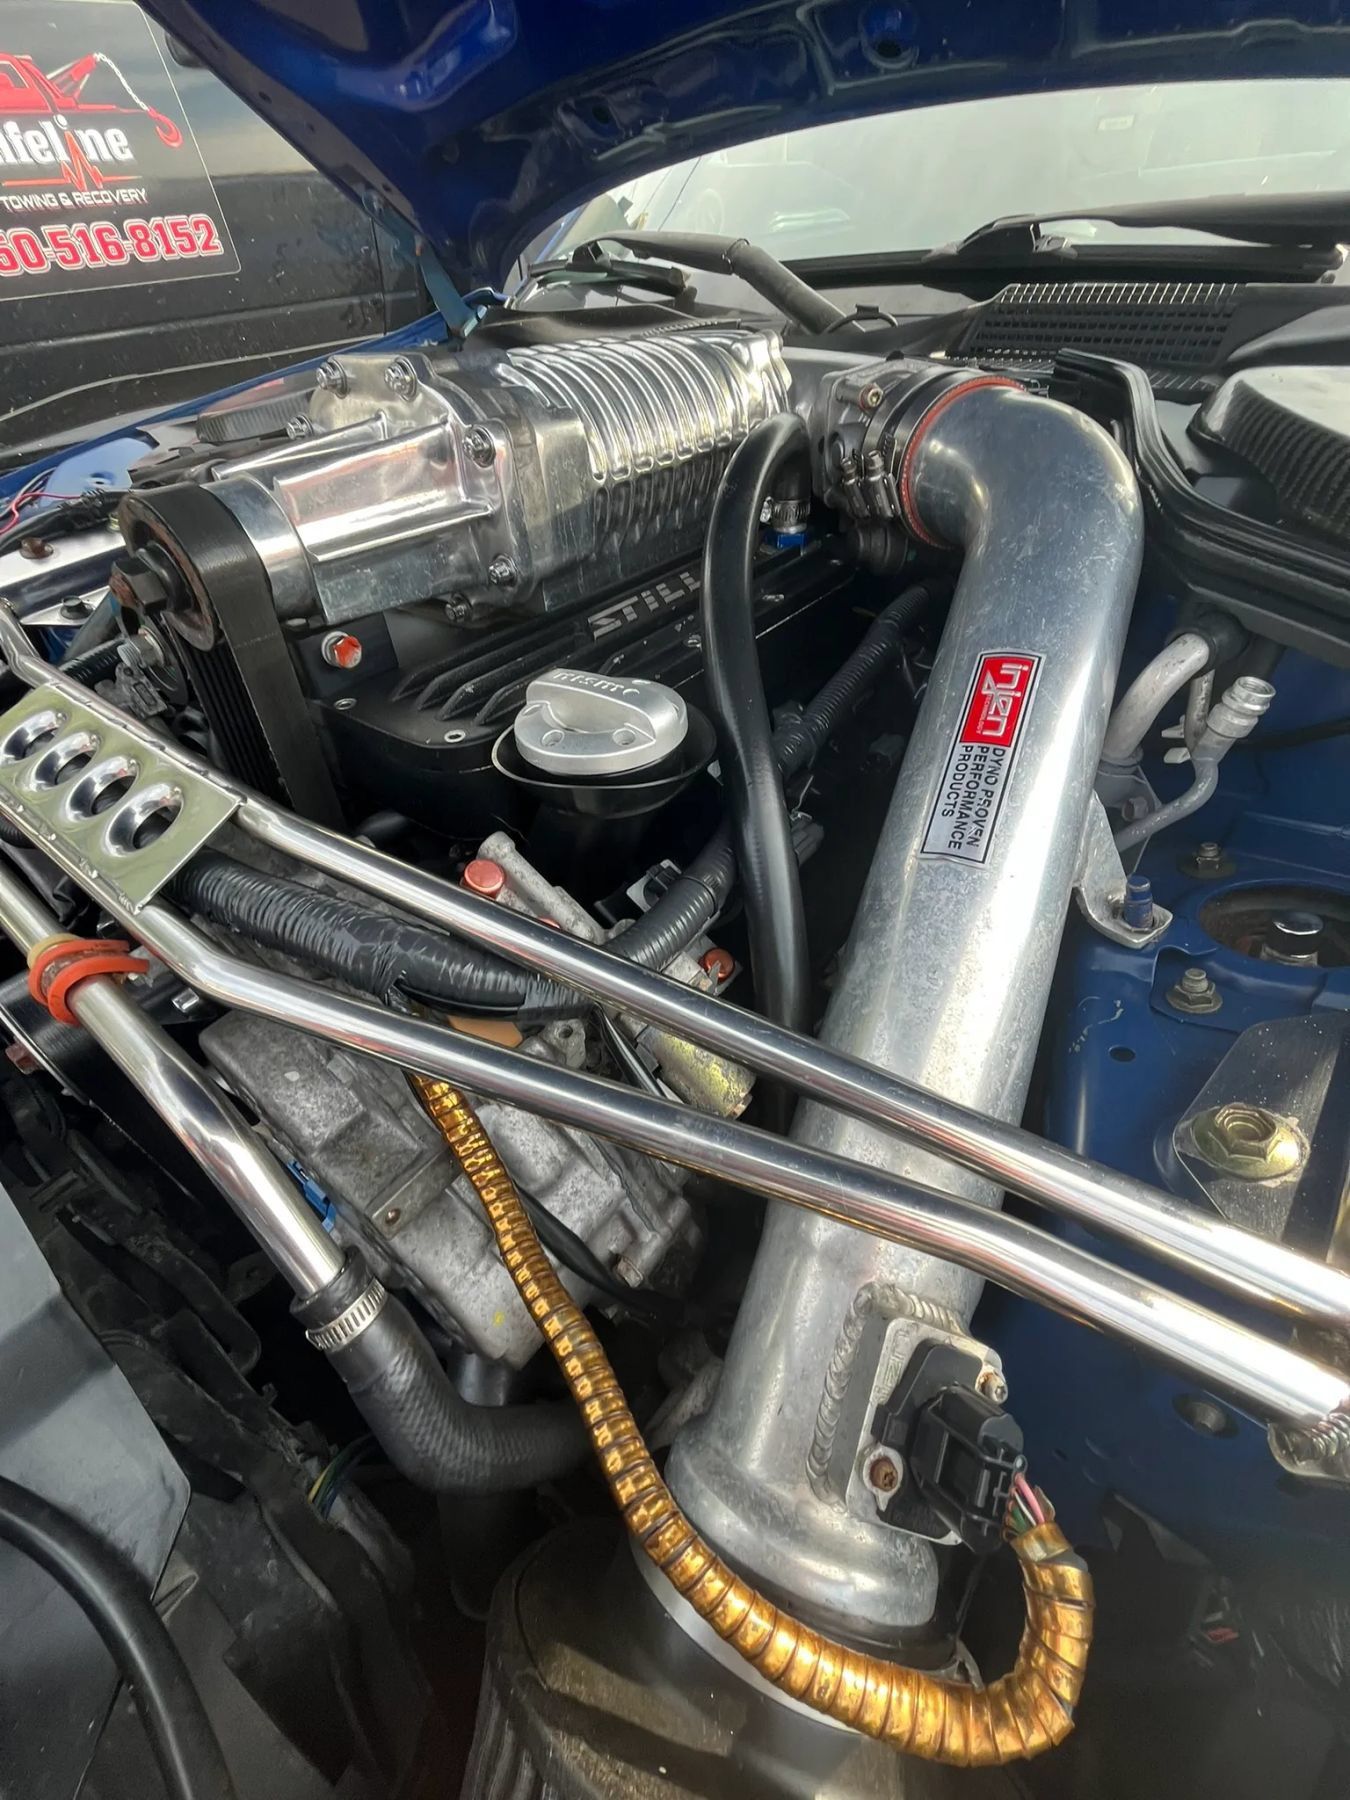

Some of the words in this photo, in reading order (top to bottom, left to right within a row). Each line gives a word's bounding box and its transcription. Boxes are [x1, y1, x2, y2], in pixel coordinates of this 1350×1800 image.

[0, 192, 60, 211] TOWING
[59, 191, 74, 206] &
[73, 188, 147, 206] RECOVERY
[976, 694, 992, 735] TECHNOLOGY
[981, 662, 1029, 738] injen
[941, 745, 974, 818] PRODUCTS
[984, 748, 1006, 786] DYNO
[947, 745, 990, 850] PERFORMANCE
[966, 788, 994, 848] PROVEN
